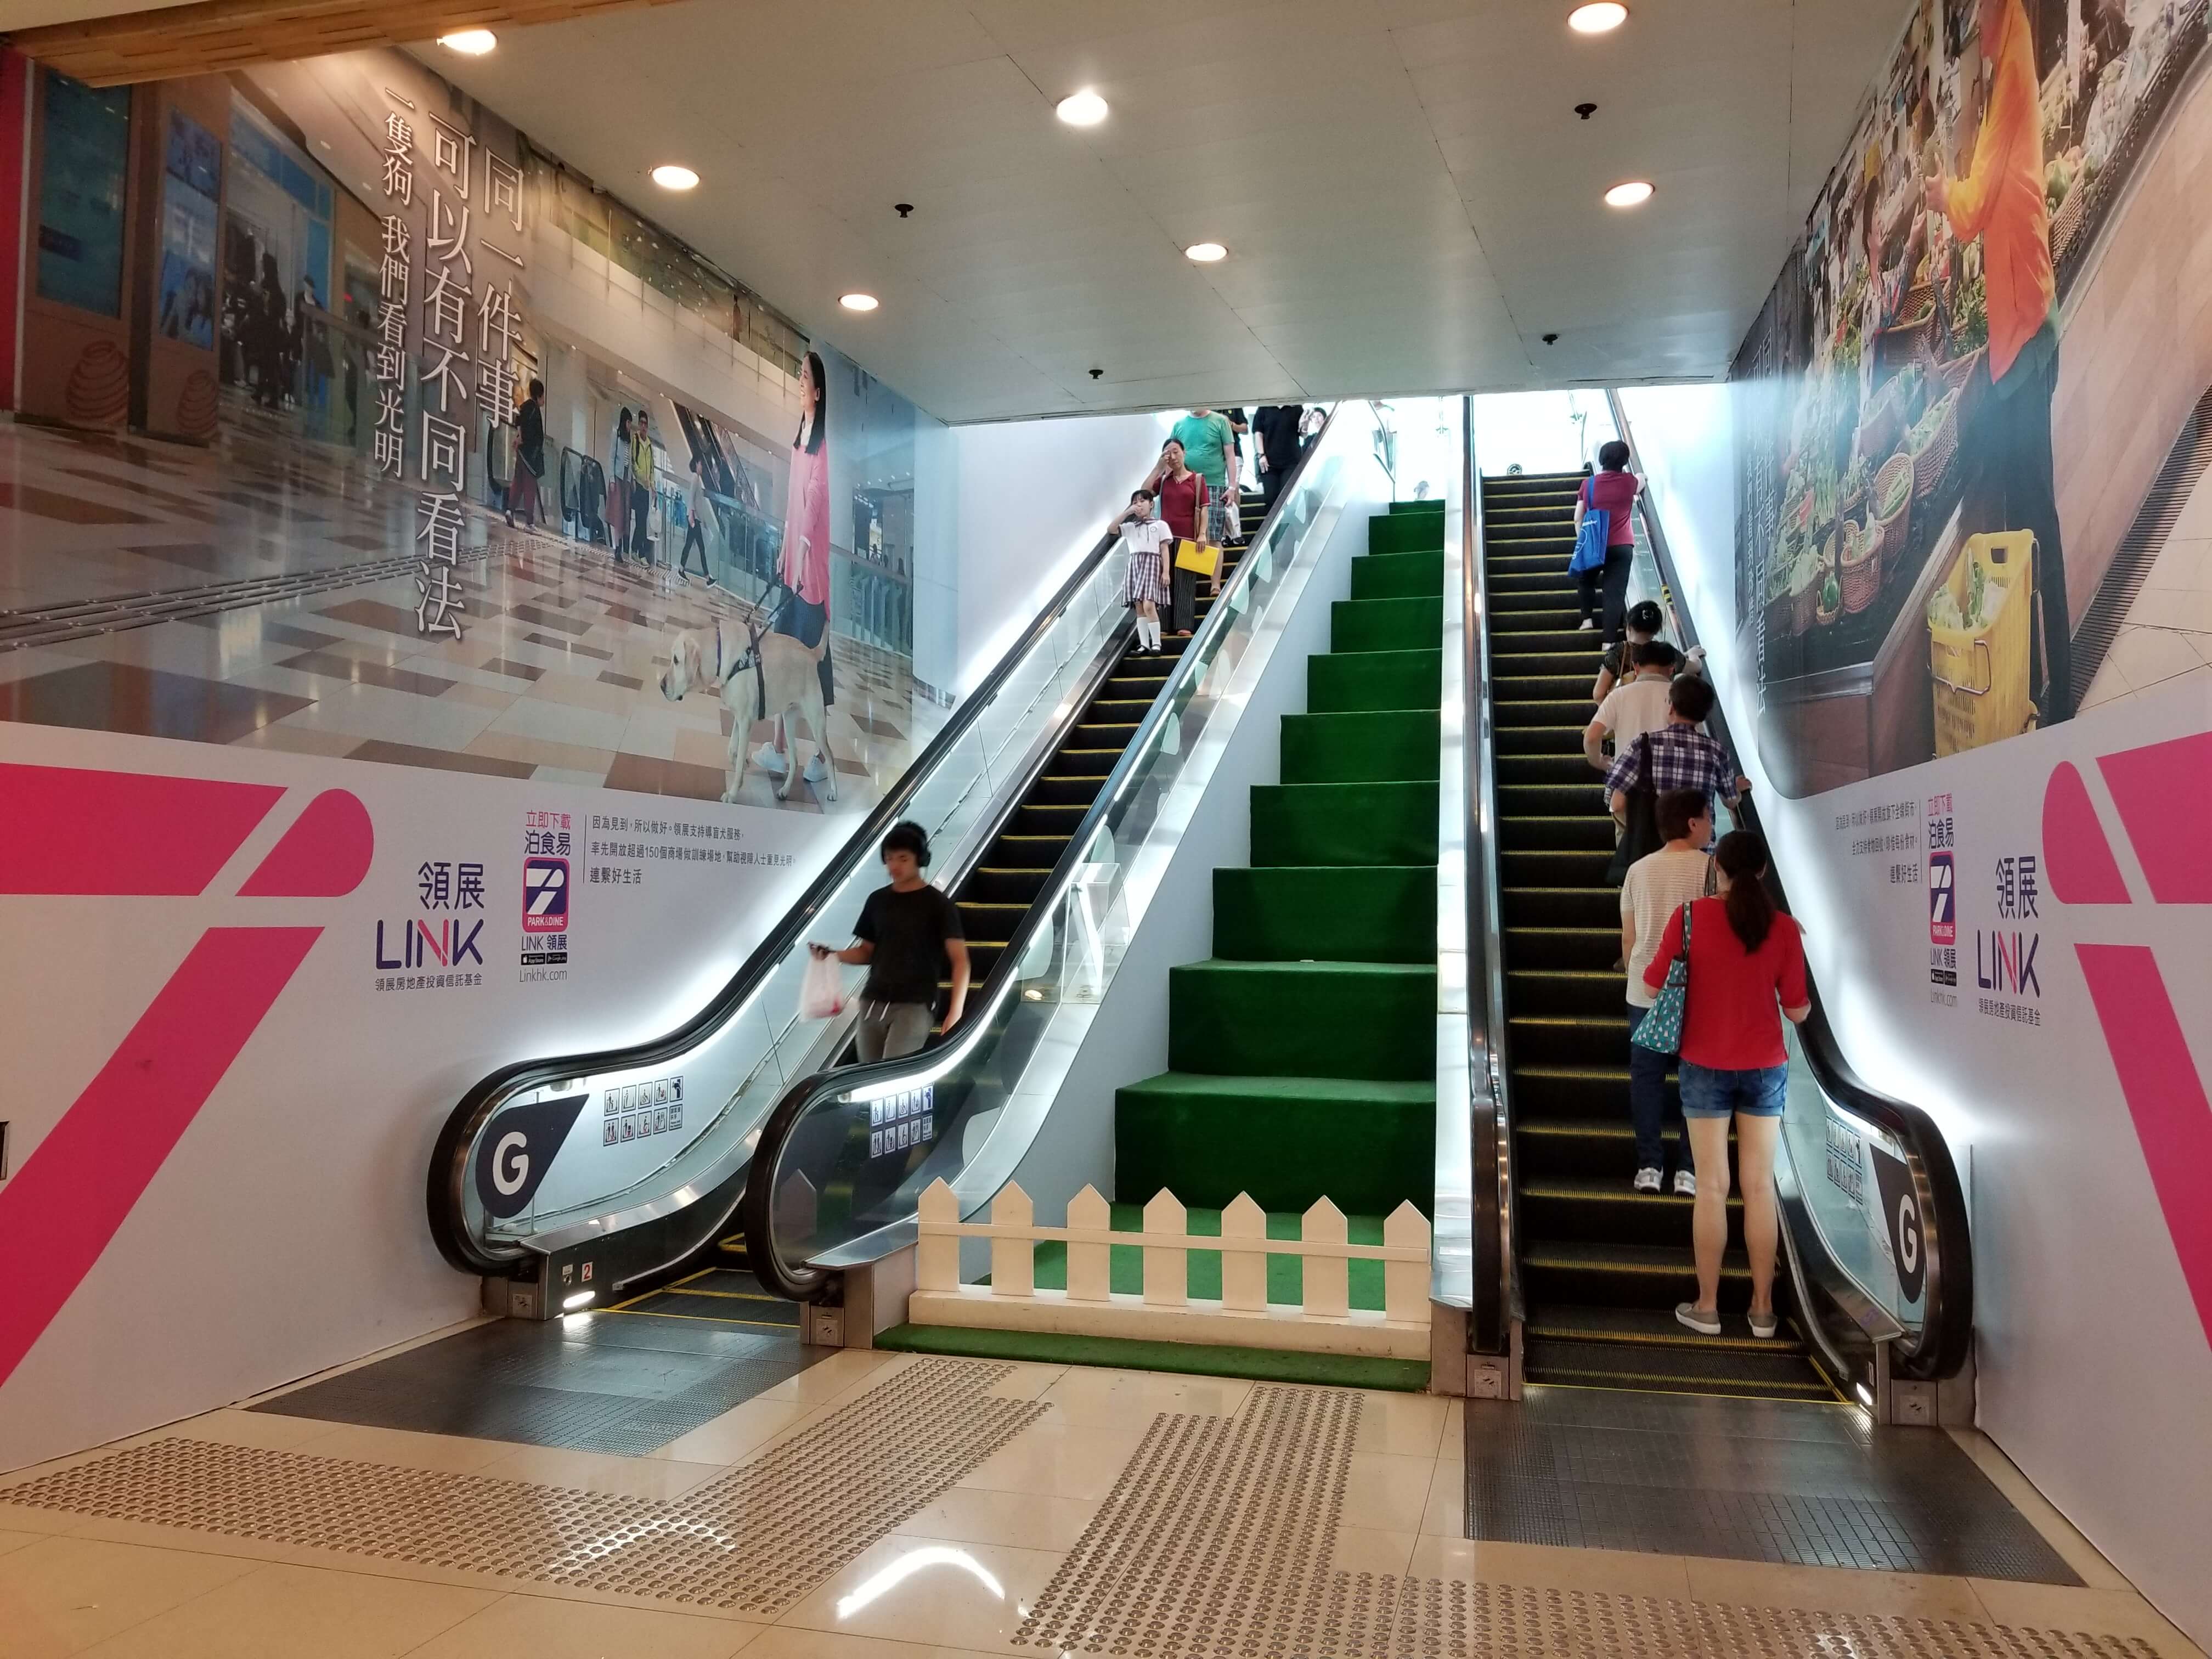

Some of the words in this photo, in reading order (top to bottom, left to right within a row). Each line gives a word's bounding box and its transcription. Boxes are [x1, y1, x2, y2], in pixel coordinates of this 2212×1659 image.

[383, 87, 415, 206] 一隻狗
[475, 146, 524, 430] 同一件事
[374, 214, 412, 478] 我們看到光明
[414, 111, 477, 641] 可以有不同看法
[526, 810, 571, 830] 立即下載
[1928, 817, 1954, 849] 泊食易
[524, 830, 571, 856] 泊食易
[418, 861, 484, 910] 領展
[590, 867, 642, 884] 連繫好生活
[1996, 856, 2038, 919] 領展
[528, 917, 563, 926] PARK&DINE
[376, 918, 484, 969] LINK
[522, 935, 544, 951] LINK
[547, 935, 567, 950] 領展
[1931, 948, 1943, 966] LINK
[1944, 948, 1956, 969] 領展
[375, 973, 482, 991] 領展房地產投資信託基金
[520, 967, 567, 983] Linkhk.com
[1977, 929, 2040, 998] LINK
[492, 1131, 529, 1195] G
[1899, 1194, 1917, 1273] G
[584, 1265, 590, 1279] 2
